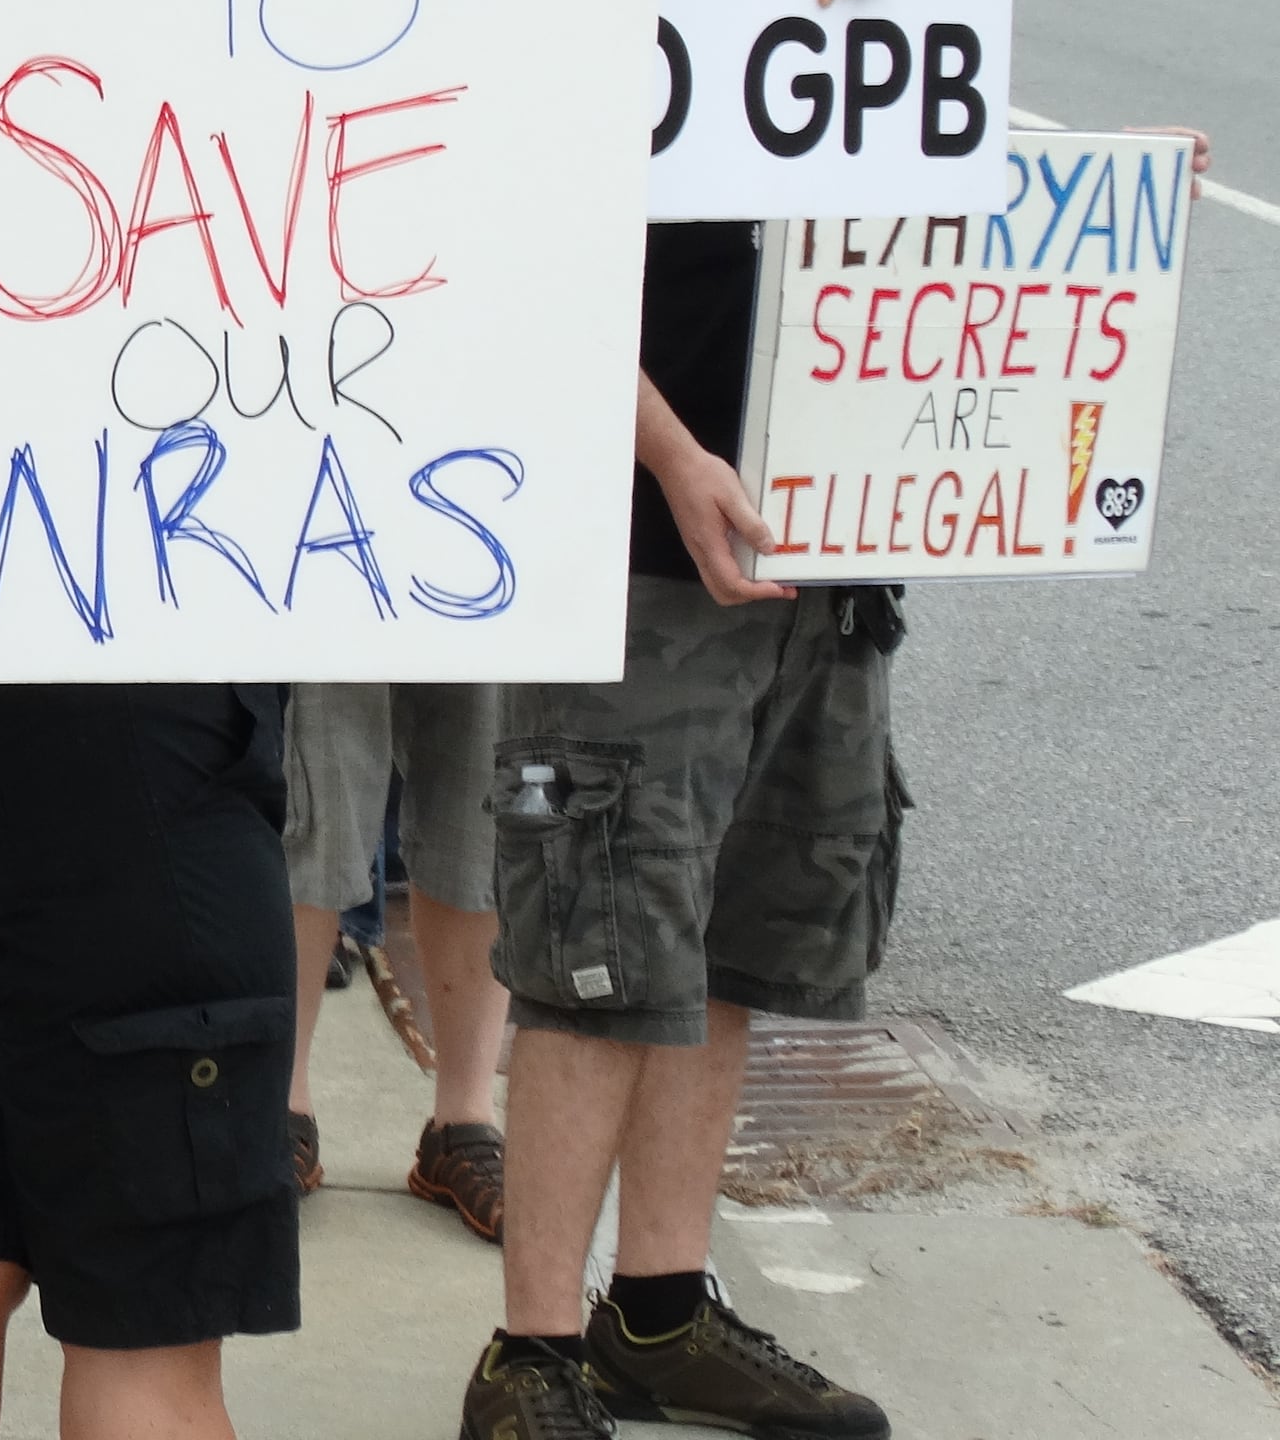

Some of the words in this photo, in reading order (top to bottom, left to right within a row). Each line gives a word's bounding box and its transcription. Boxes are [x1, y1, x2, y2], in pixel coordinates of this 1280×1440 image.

[744, 16, 988, 158] GPB
[982, 149, 1187, 273] RYAN
[112, 301, 403, 442] OUR
[810, 282, 1137, 382] SECRETS
[901, 387, 1019, 451] ARE
